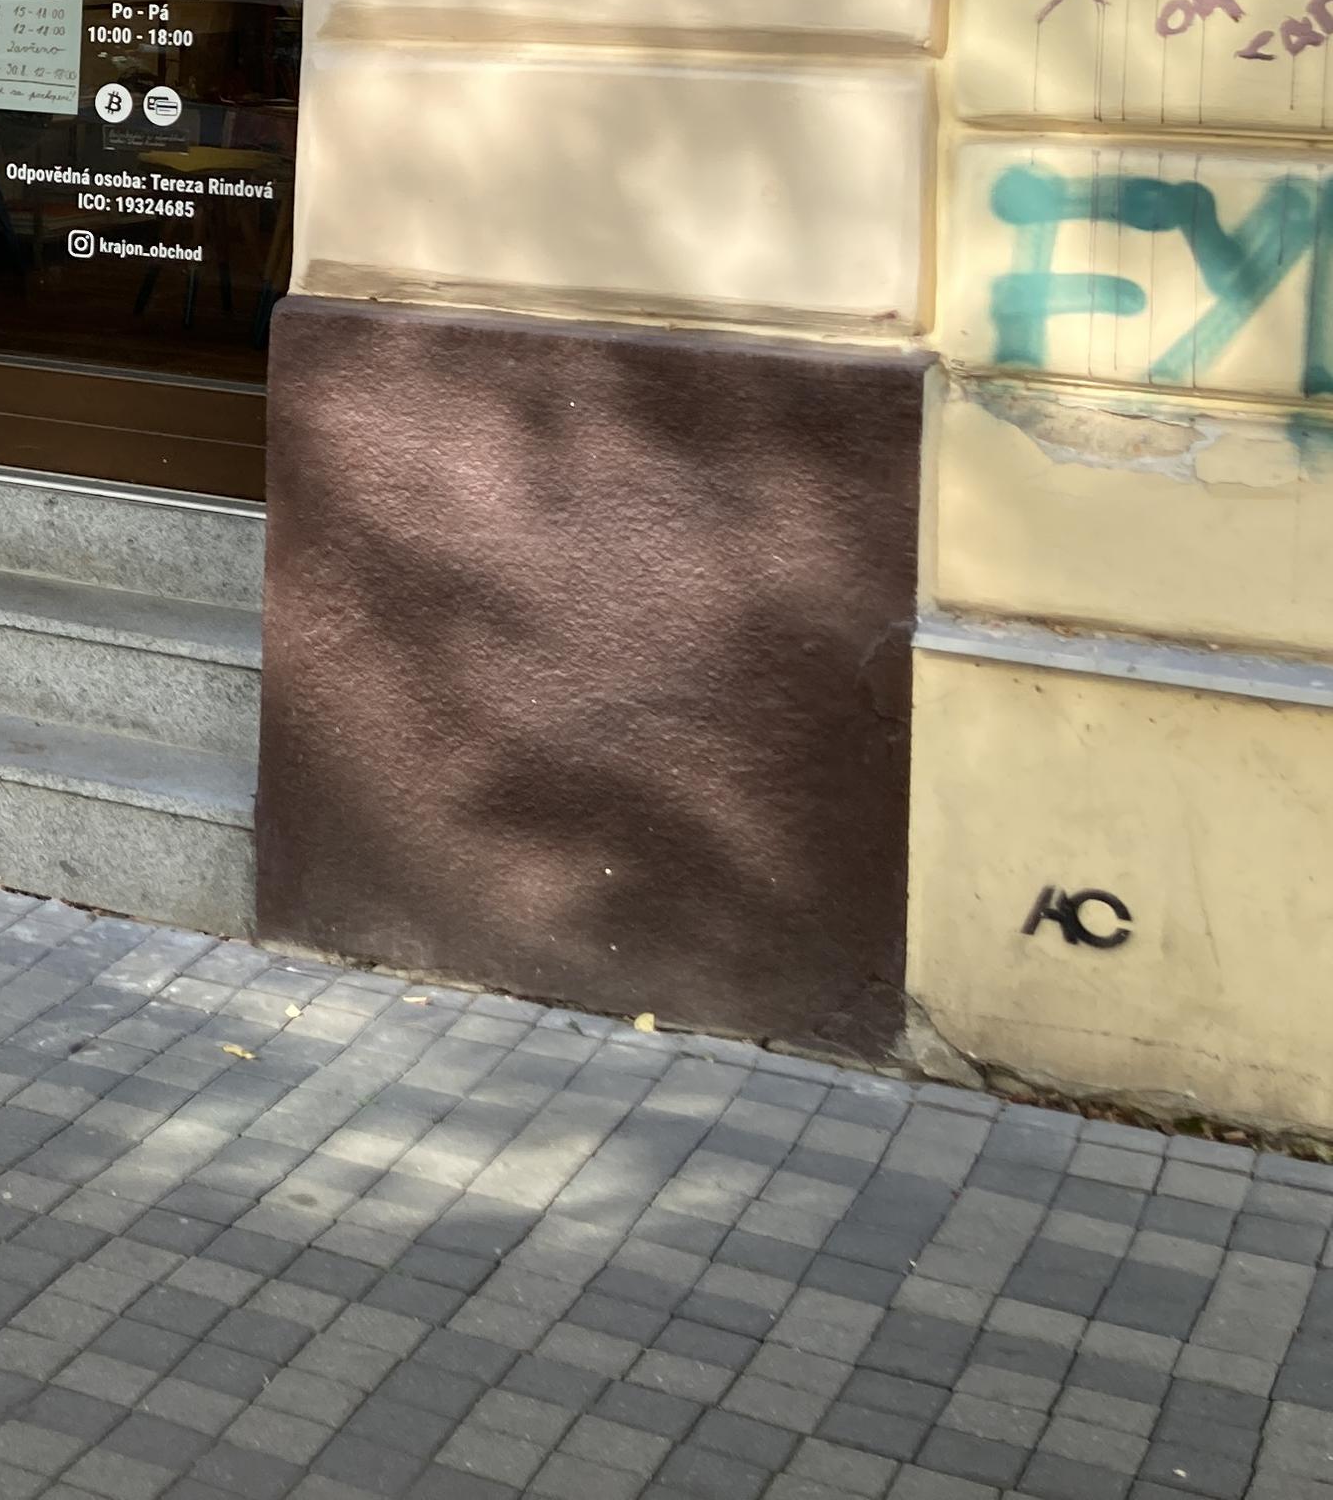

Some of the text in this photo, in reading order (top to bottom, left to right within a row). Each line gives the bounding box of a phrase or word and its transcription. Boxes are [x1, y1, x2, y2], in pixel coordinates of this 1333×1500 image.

[111, 3, 133, 20] Po
[148, 3, 169, 21] Pá
[87, 26, 132, 45] 10:00
[149, 29, 193, 47] 18:00
[6, 163, 273, 199] Odpovědná osoba: Tereza Rindová
[78, 193, 195, 218] ICO: 19324685
[99, 236, 203, 262] krajon_obchod
